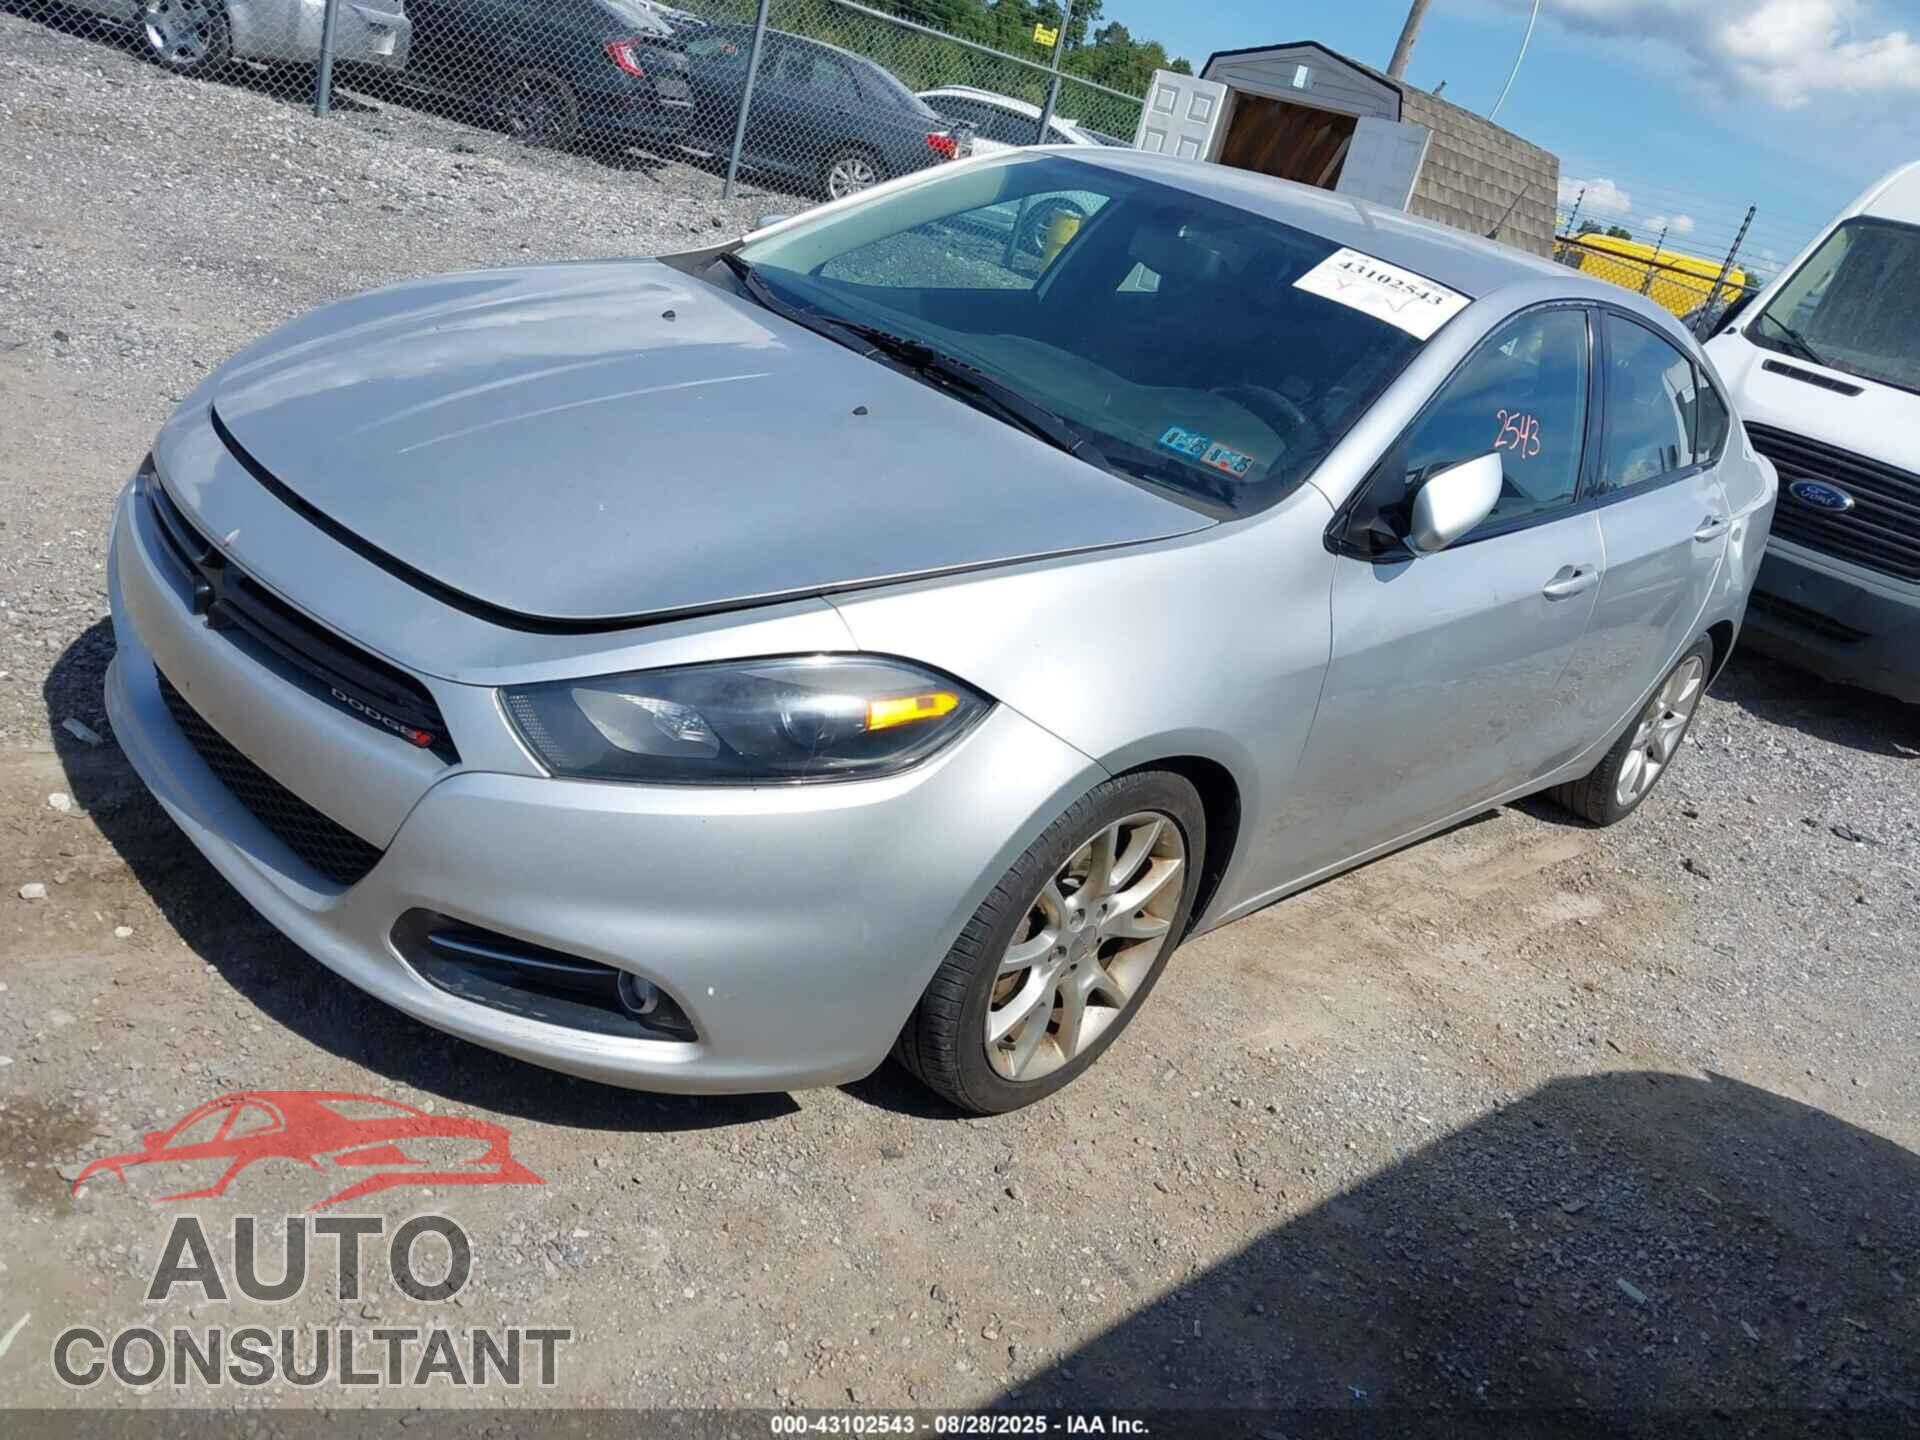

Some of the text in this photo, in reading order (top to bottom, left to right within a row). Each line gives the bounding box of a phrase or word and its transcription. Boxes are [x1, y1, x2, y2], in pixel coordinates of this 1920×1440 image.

[1337, 261, 1443, 306] 43102543
[1494, 409, 1541, 459] 2543
[1800, 485, 1836, 505] Ford
